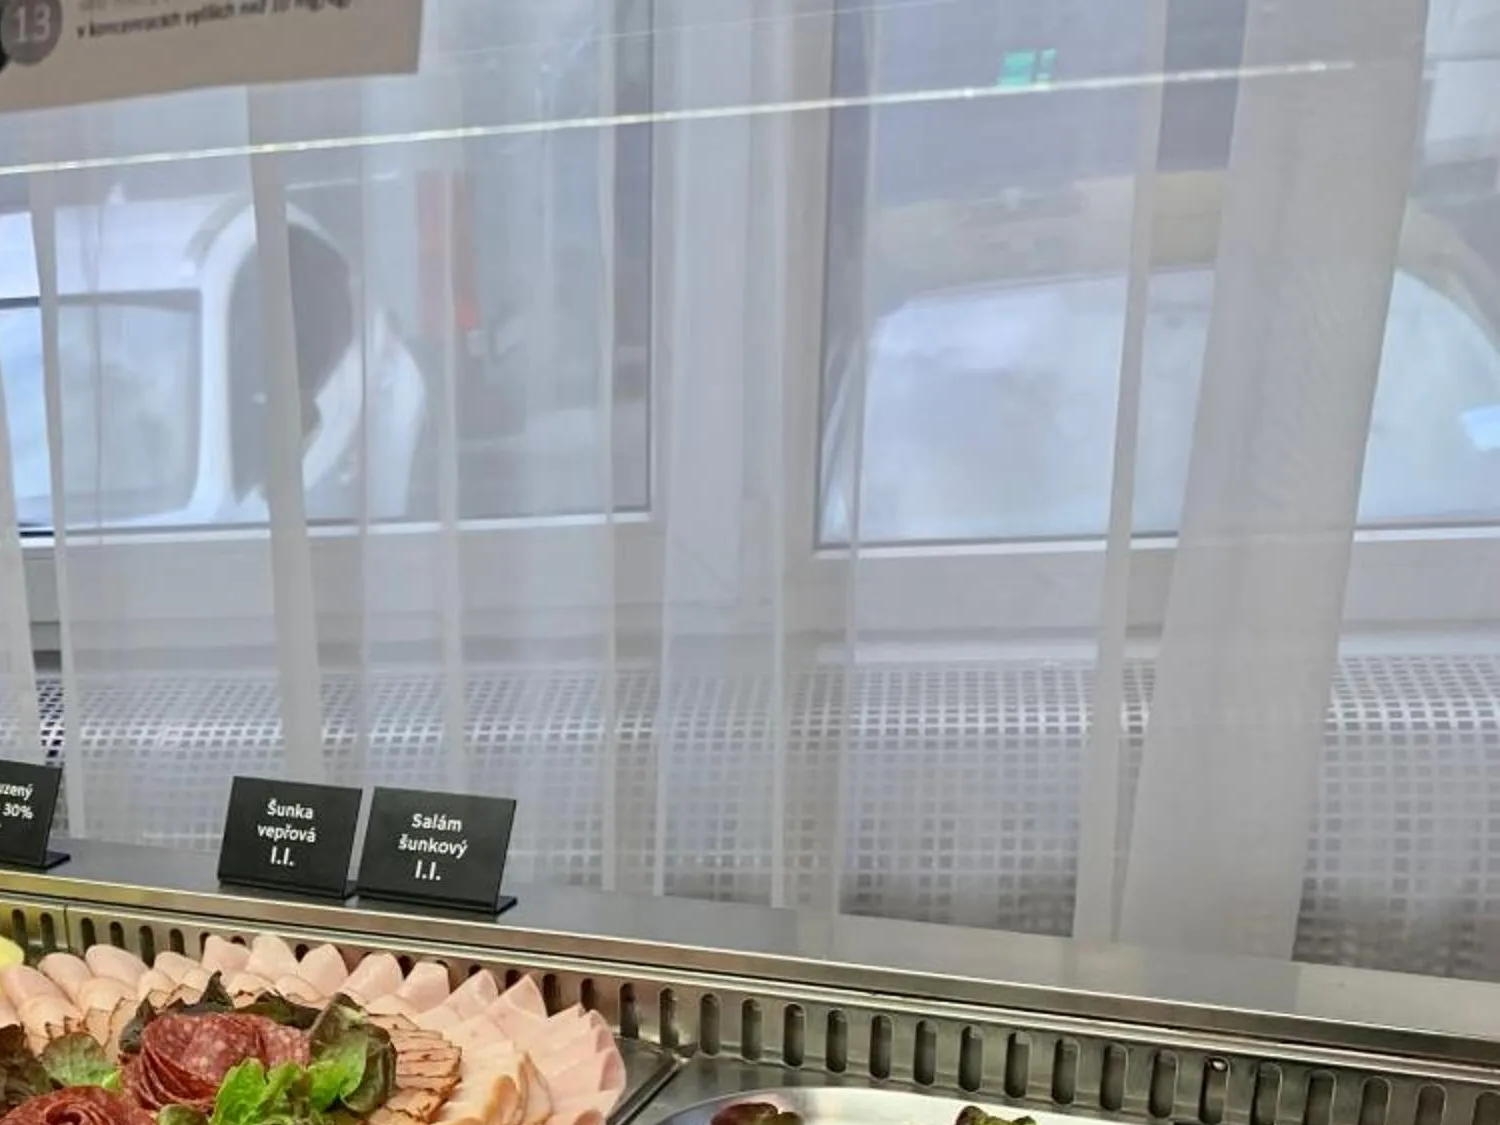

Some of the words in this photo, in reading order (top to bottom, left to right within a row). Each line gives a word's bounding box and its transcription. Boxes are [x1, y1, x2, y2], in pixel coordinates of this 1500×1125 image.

[15, 4, 52, 43] 13
[3, 801, 34, 820] 30%
[266, 798, 314, 820] Šunka
[411, 812, 463, 832] Salám
[257, 824, 317, 844] vepřová
[398, 834, 468, 858] šunkový
